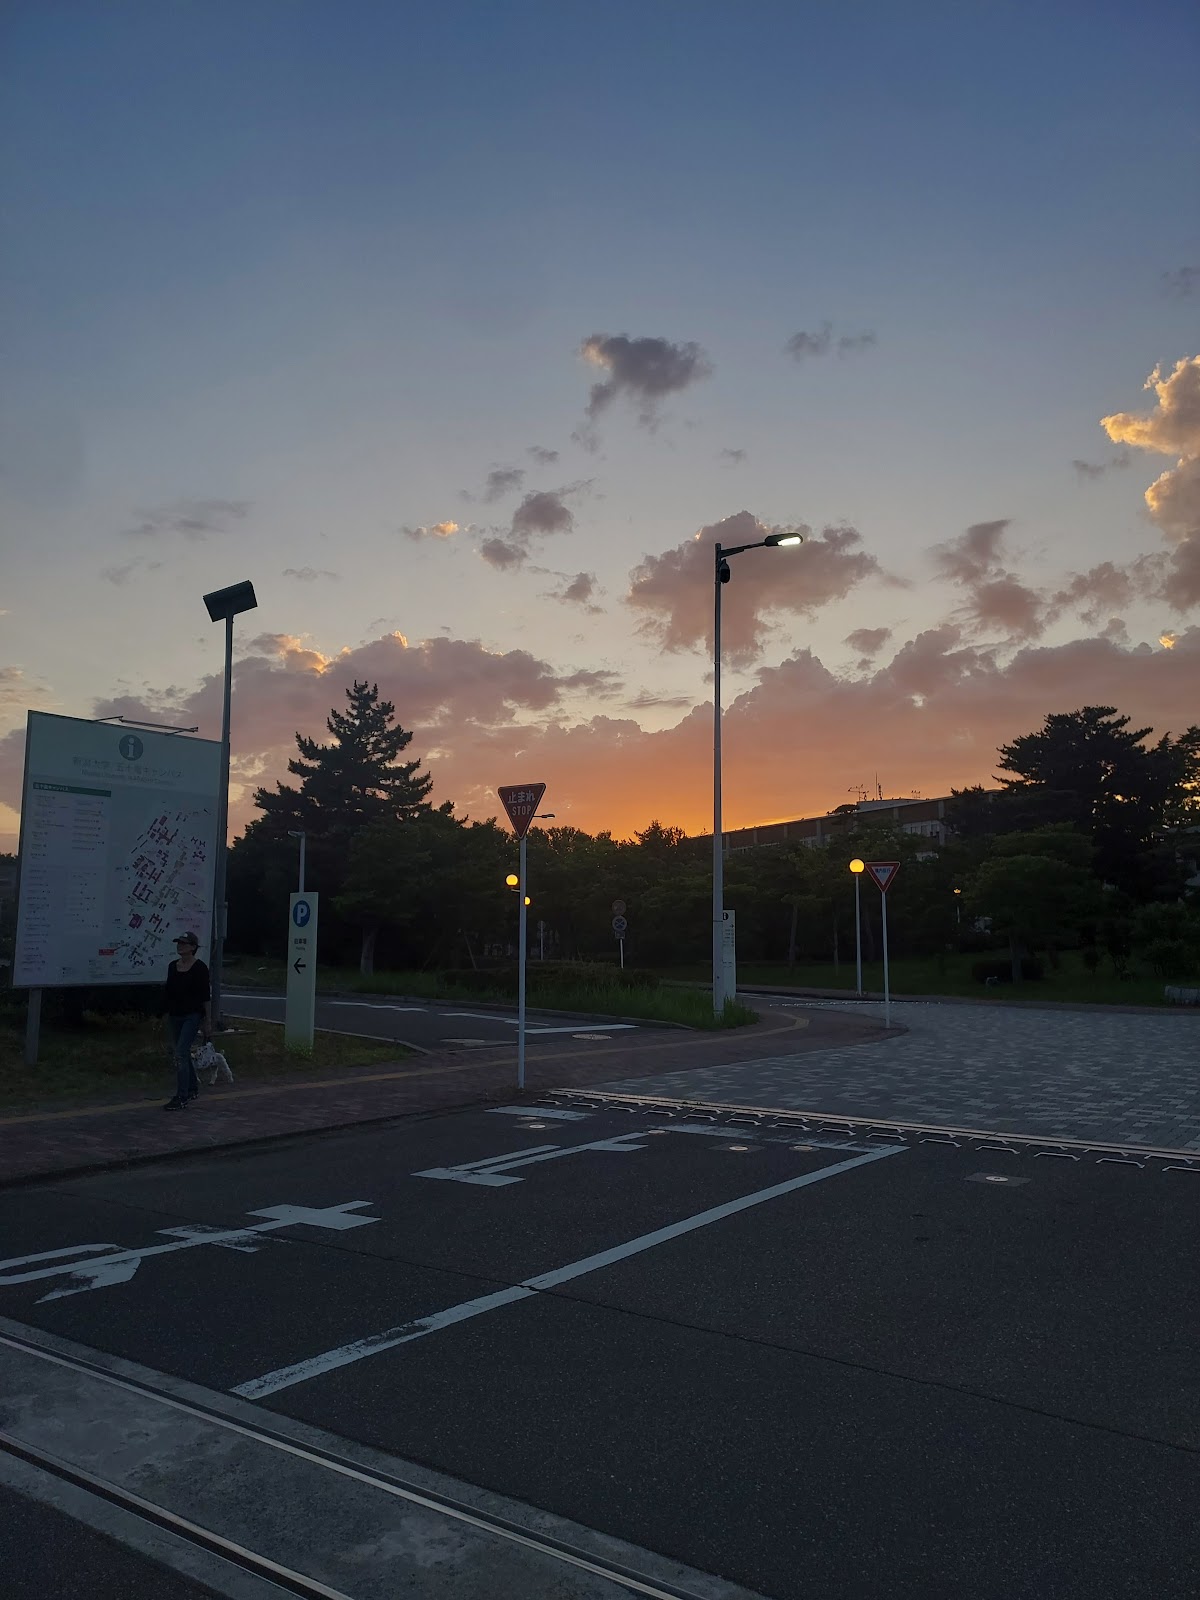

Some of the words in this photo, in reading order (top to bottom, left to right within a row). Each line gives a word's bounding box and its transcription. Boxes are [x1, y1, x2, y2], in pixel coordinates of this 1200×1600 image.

[507, 790, 536, 804] 止まれ
[512, 805, 532, 816] STOP
[296, 904, 308, 924] P
